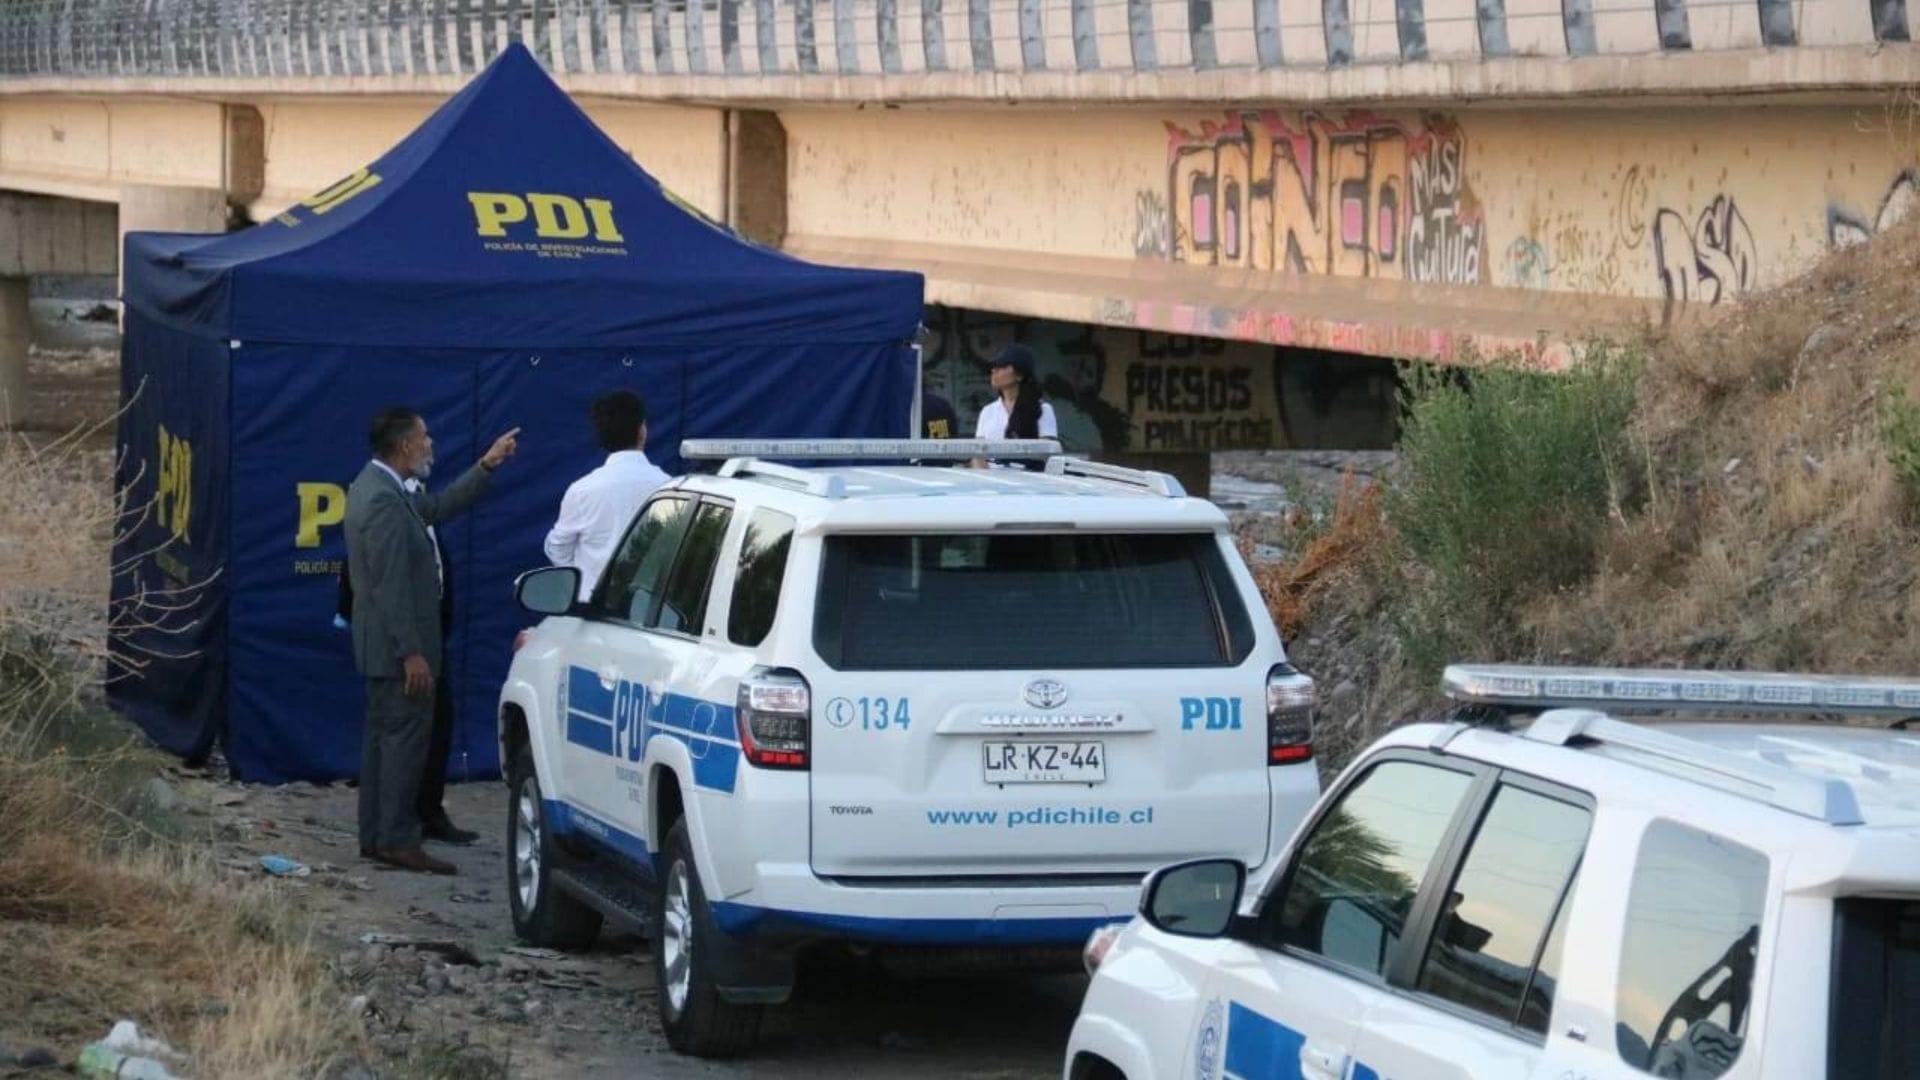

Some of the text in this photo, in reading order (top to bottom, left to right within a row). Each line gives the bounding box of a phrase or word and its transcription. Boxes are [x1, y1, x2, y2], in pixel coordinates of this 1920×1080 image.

[467, 191, 624, 243] PDI
[1125, 362, 1252, 414] PRESOS
[927, 419, 949, 439] PDI
[157, 423, 192, 545] PDI
[857, 696, 911, 731] 134
[1179, 697, 1243, 731] PDI
[829, 806, 874, 816] TOYOTA
